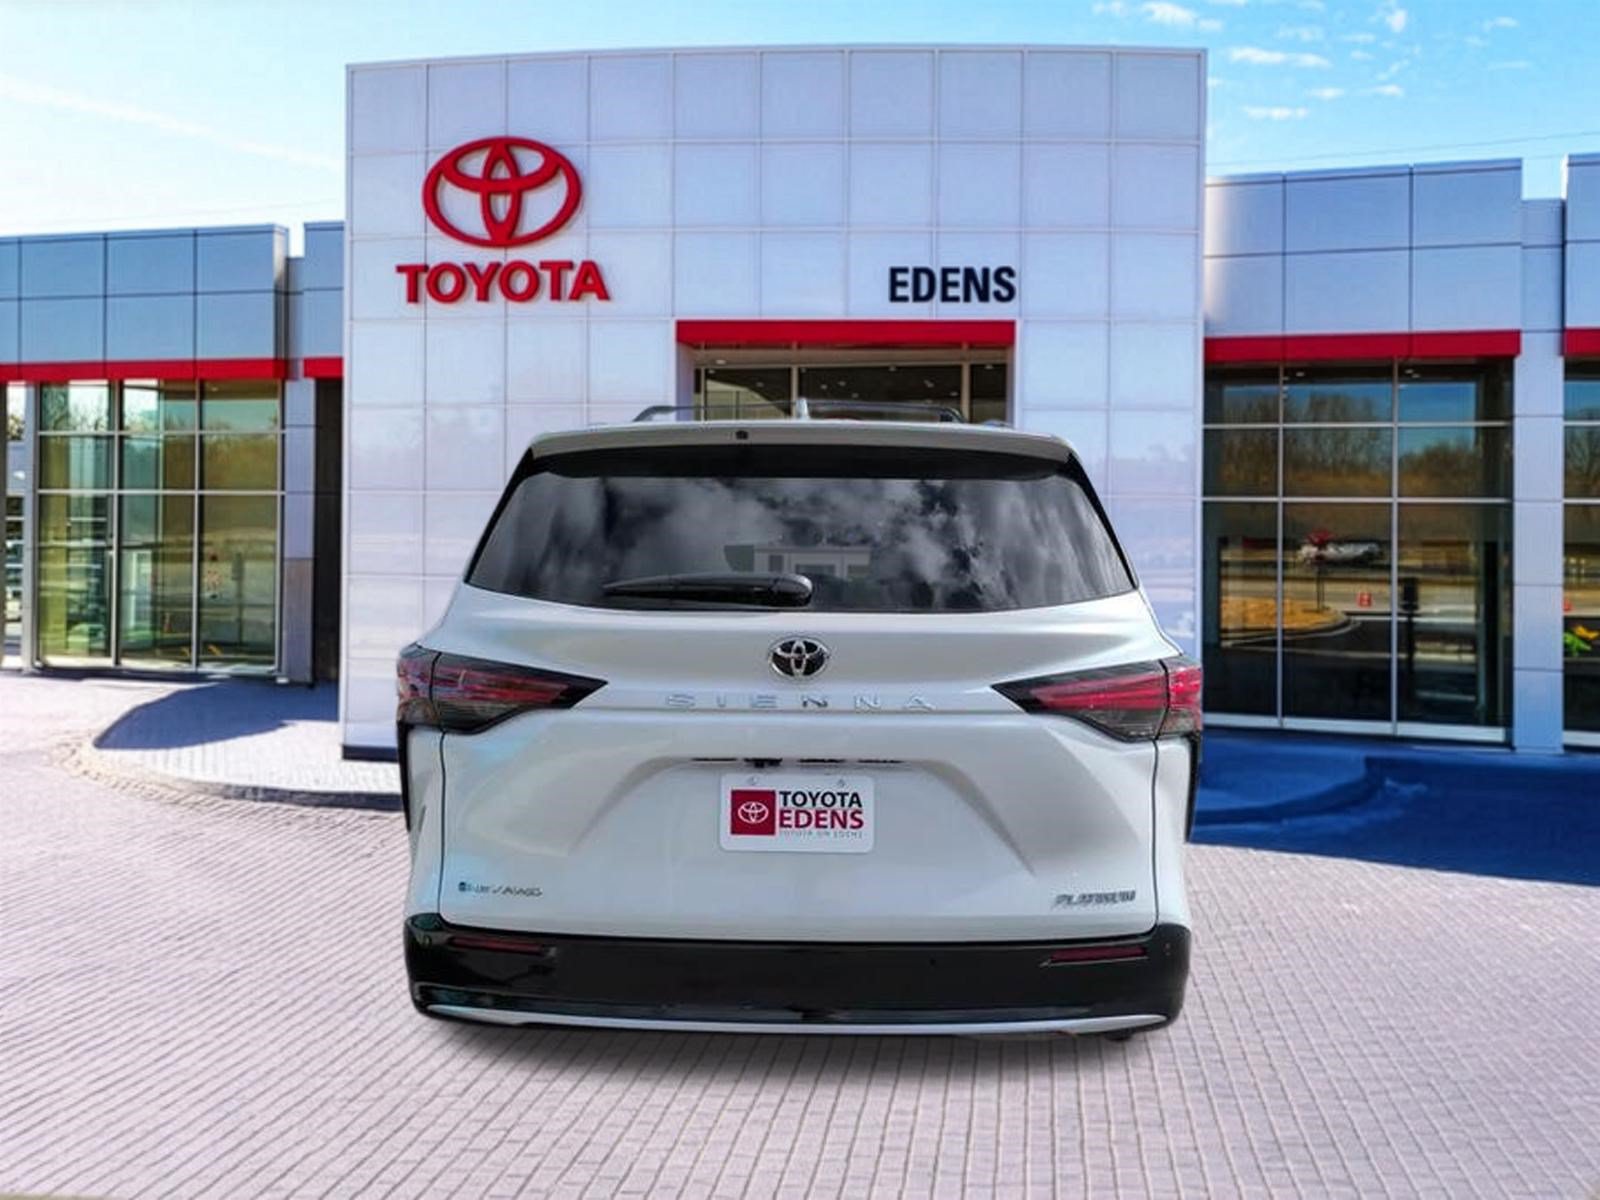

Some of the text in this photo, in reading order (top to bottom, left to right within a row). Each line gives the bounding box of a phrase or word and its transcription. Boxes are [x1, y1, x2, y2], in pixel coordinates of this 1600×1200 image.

[396, 260, 610, 304] TOYOTA
[889, 266, 1016, 303] EDENS
[665, 694, 936, 710] SIENNA
[779, 790, 863, 808] TOYOTA
[779, 809, 864, 829] EDENS
